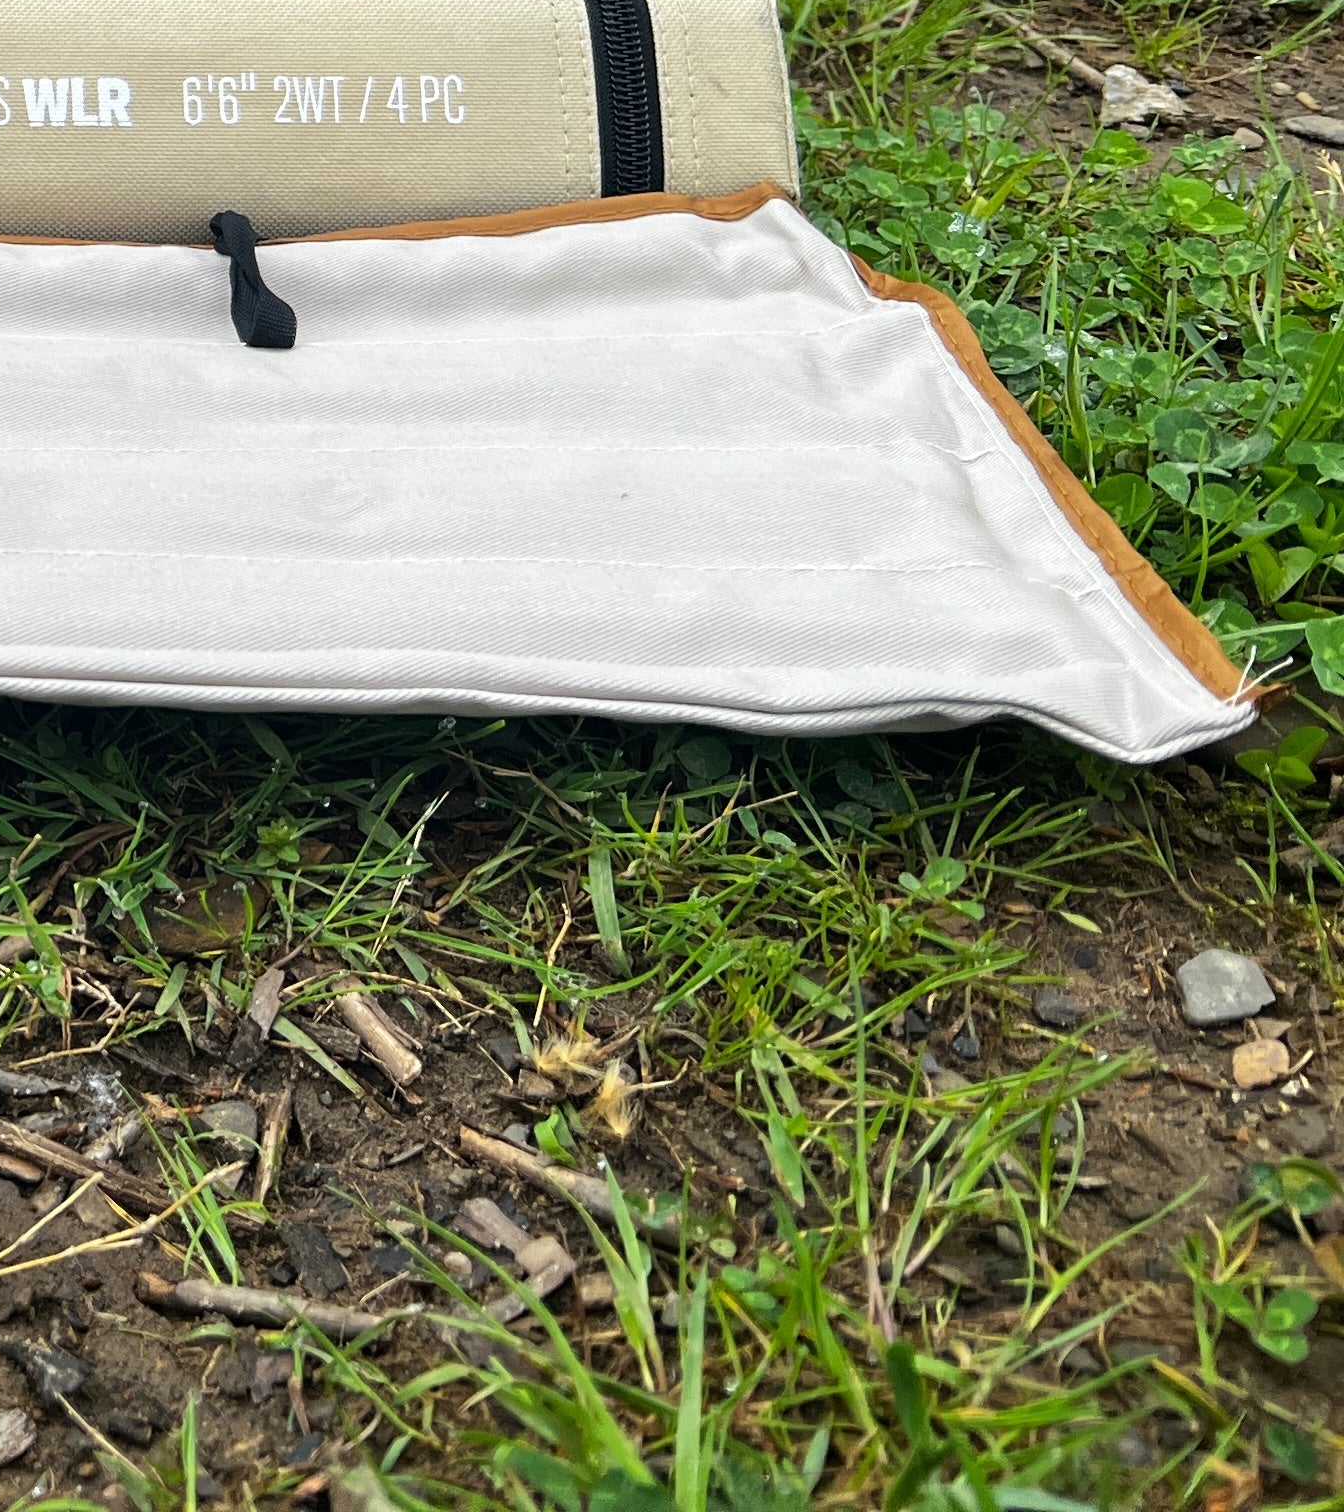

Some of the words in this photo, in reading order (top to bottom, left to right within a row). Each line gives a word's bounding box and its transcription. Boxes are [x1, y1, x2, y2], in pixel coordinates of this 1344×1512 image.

[22, 78, 132, 126] WLR
[273, 75, 344, 123] 2WT
[421, 75, 466, 124] PC
